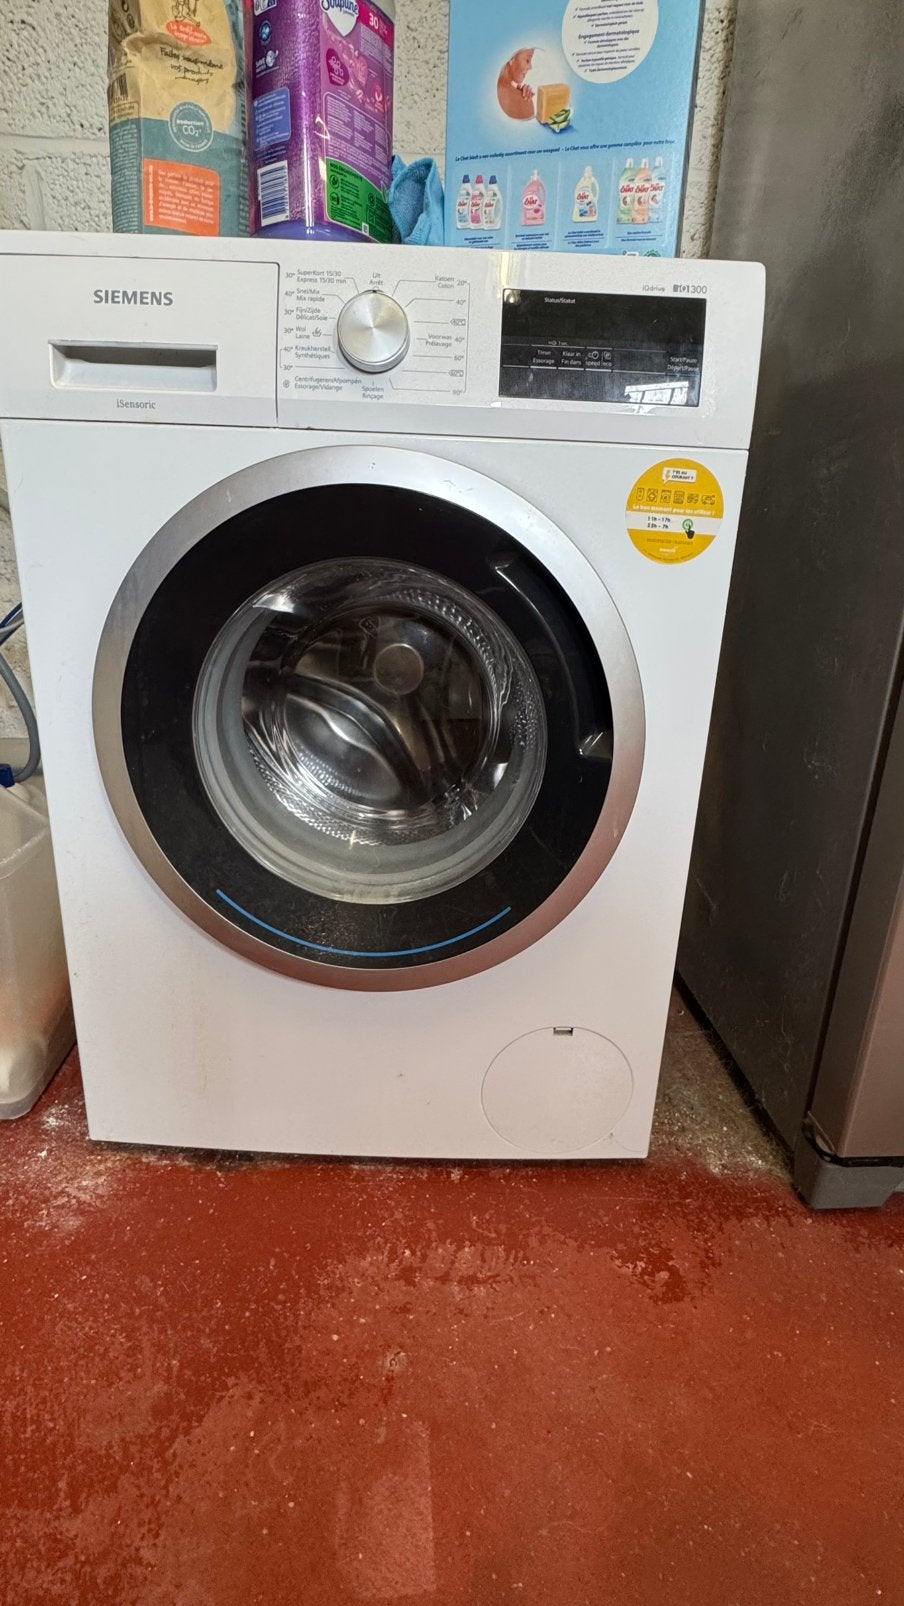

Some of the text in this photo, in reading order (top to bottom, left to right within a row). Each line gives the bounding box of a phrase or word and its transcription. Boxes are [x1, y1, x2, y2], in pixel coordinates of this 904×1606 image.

[369, 12, 379, 29] 30
[93, 289, 174, 306] SIEMENS
[428, 333, 452, 341] Voorwas
[426, 340, 452, 348] Prélavage
[295, 352, 330, 360] Synthétiques
[294, 382, 343, 392] Essorage/Vidange
[362, 384, 384, 394] Spoelen
[362, 392, 384, 400] Rinçage
[116, 398, 156, 410] iSensoric
